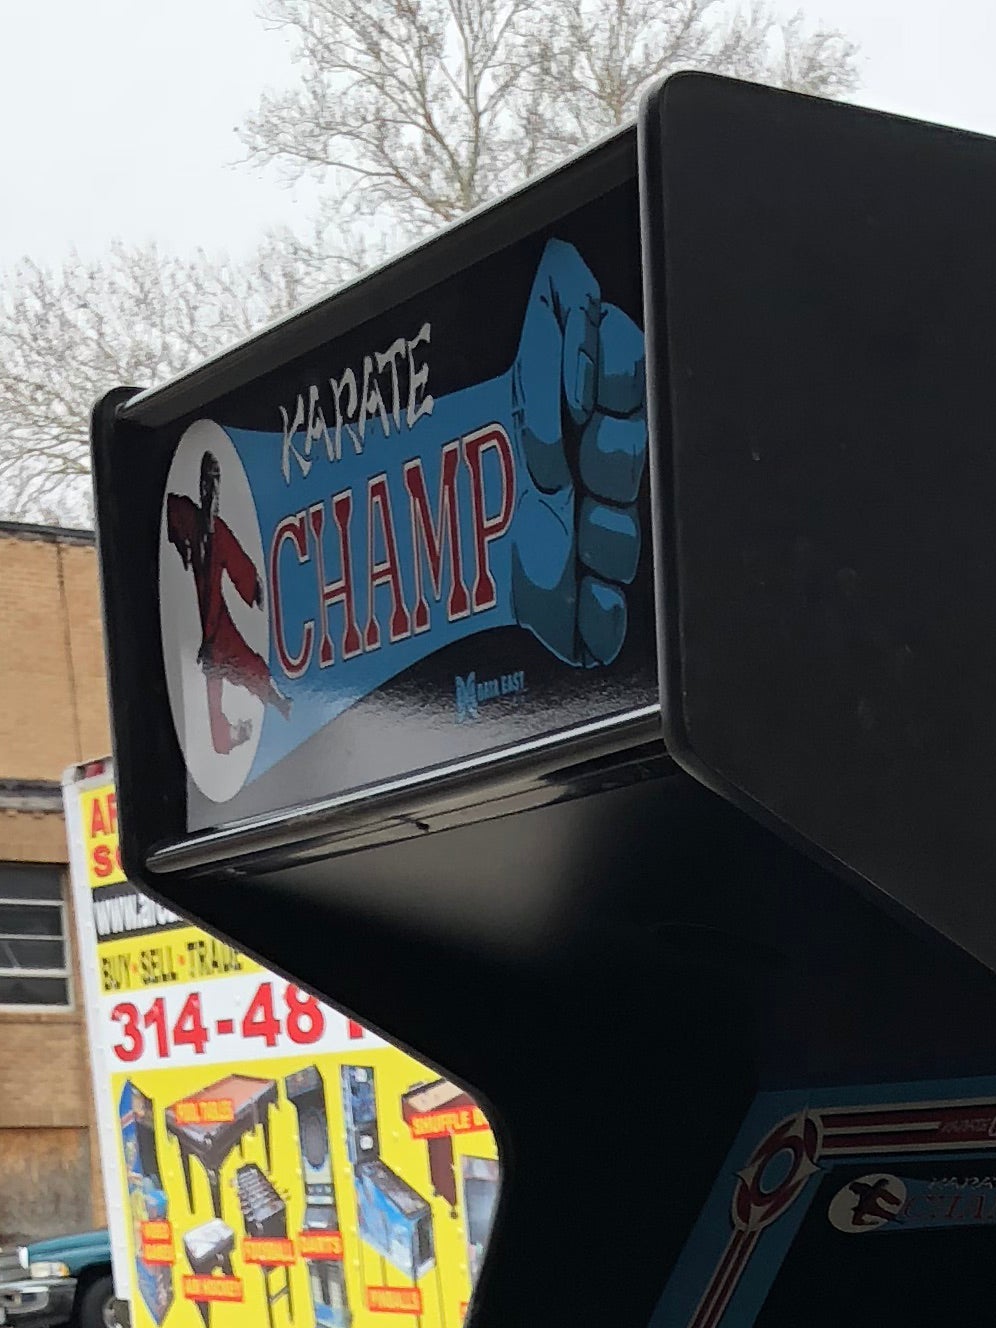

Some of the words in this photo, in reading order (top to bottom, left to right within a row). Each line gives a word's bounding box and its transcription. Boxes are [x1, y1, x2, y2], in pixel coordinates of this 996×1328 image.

[279, 322, 433, 483] KARATE
[270, 422, 516, 680] CHAMP
[102, 953, 132, 990] BUY
[140, 945, 178, 985] SELL
